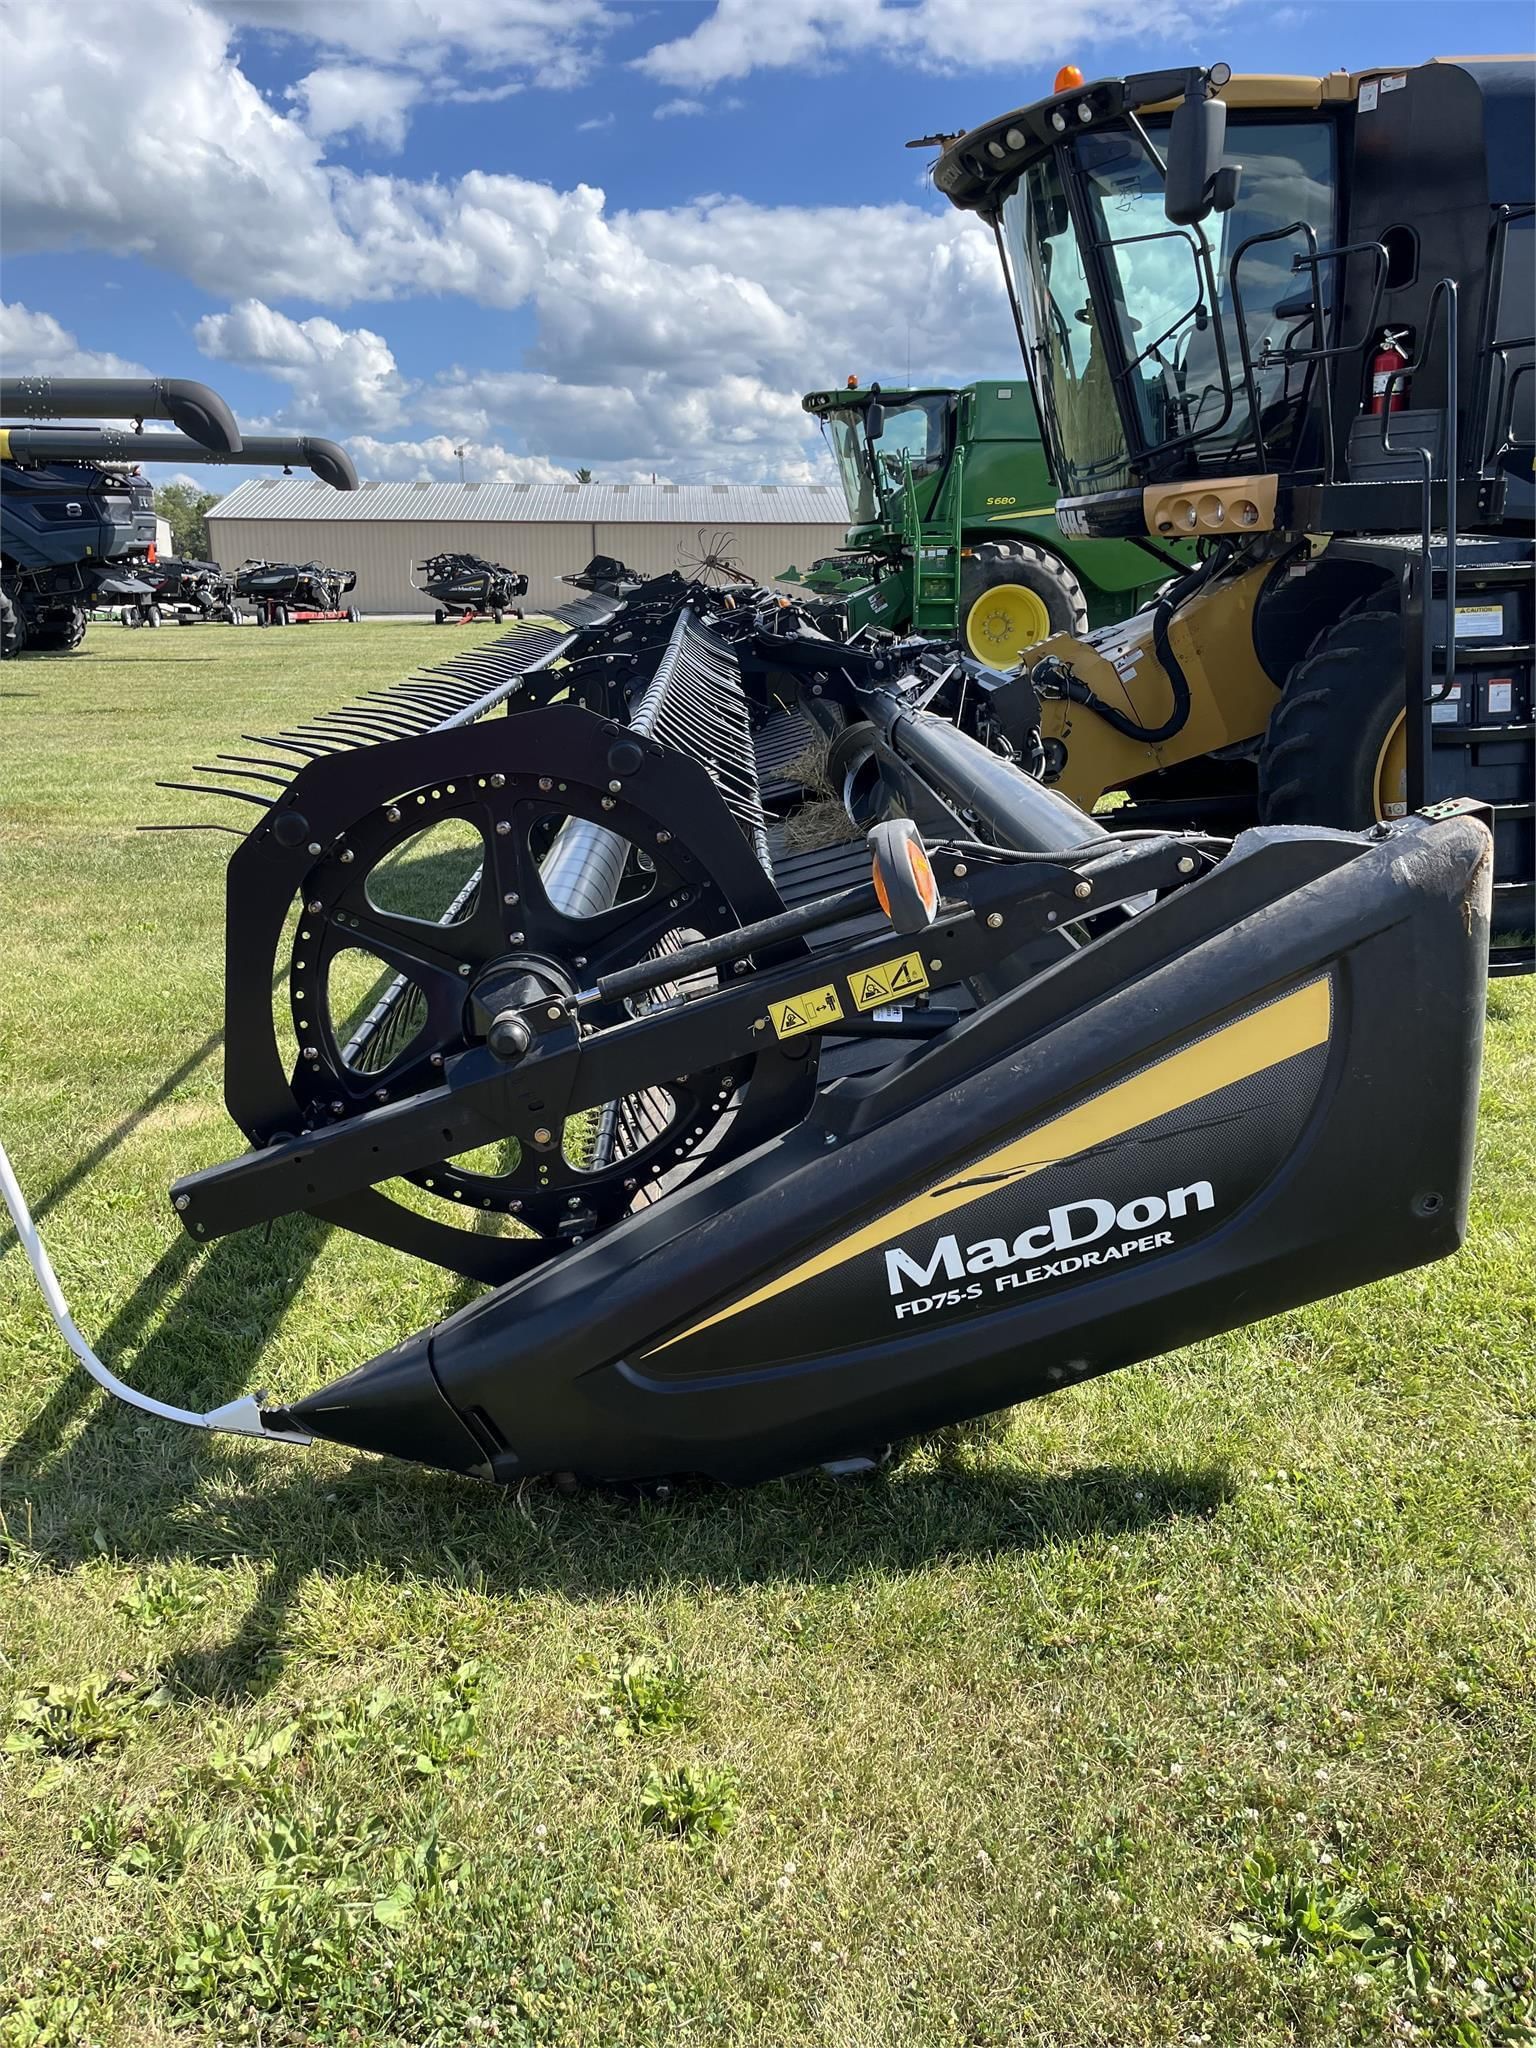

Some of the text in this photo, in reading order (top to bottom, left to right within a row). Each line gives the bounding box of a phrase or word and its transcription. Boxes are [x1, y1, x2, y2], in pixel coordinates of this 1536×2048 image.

[986, 496, 1016, 505] S680
[884, 1180, 1215, 1296] MacDon
[895, 1230, 1175, 1320] FD75-S FLEXDRAPER
